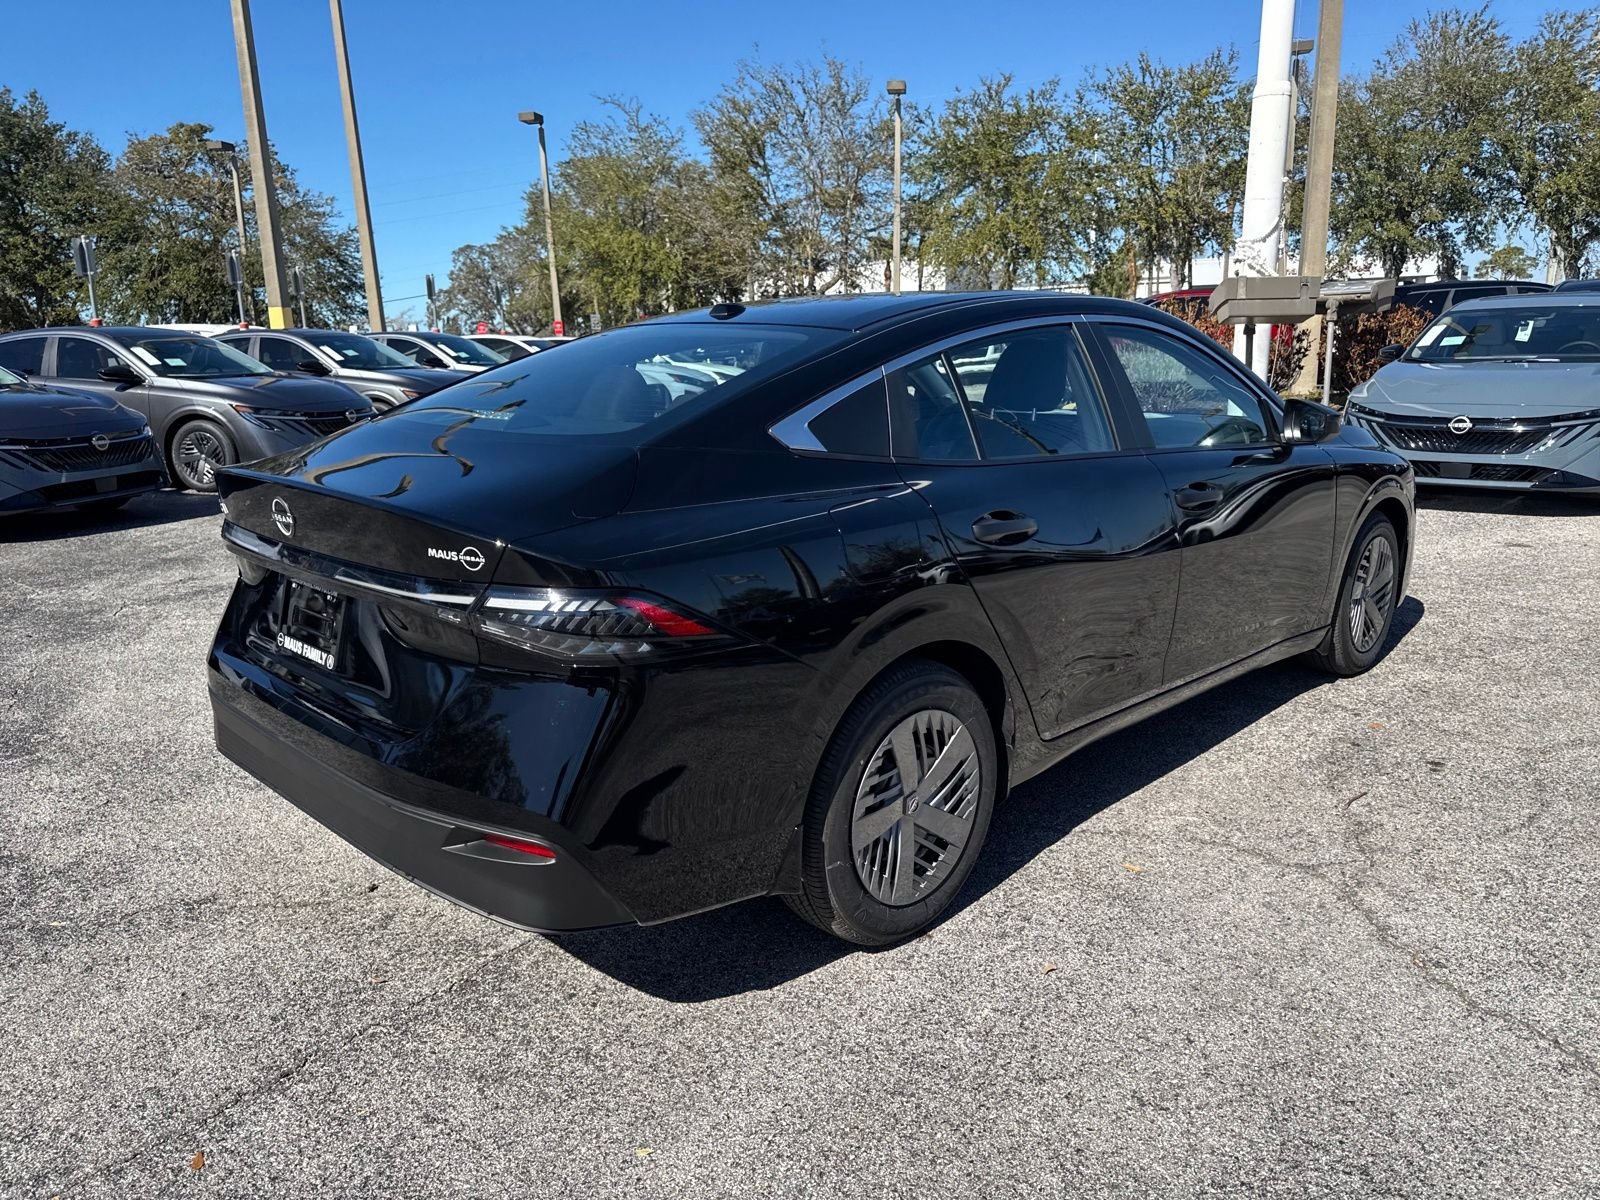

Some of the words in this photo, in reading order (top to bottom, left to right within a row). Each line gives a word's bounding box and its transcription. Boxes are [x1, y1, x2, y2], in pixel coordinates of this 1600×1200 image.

[428, 547, 458, 561] MAUS
[459, 554, 486, 563] NISSAN
[283, 635, 303, 655] MAUS
[302, 643, 328, 666] FAMILY
